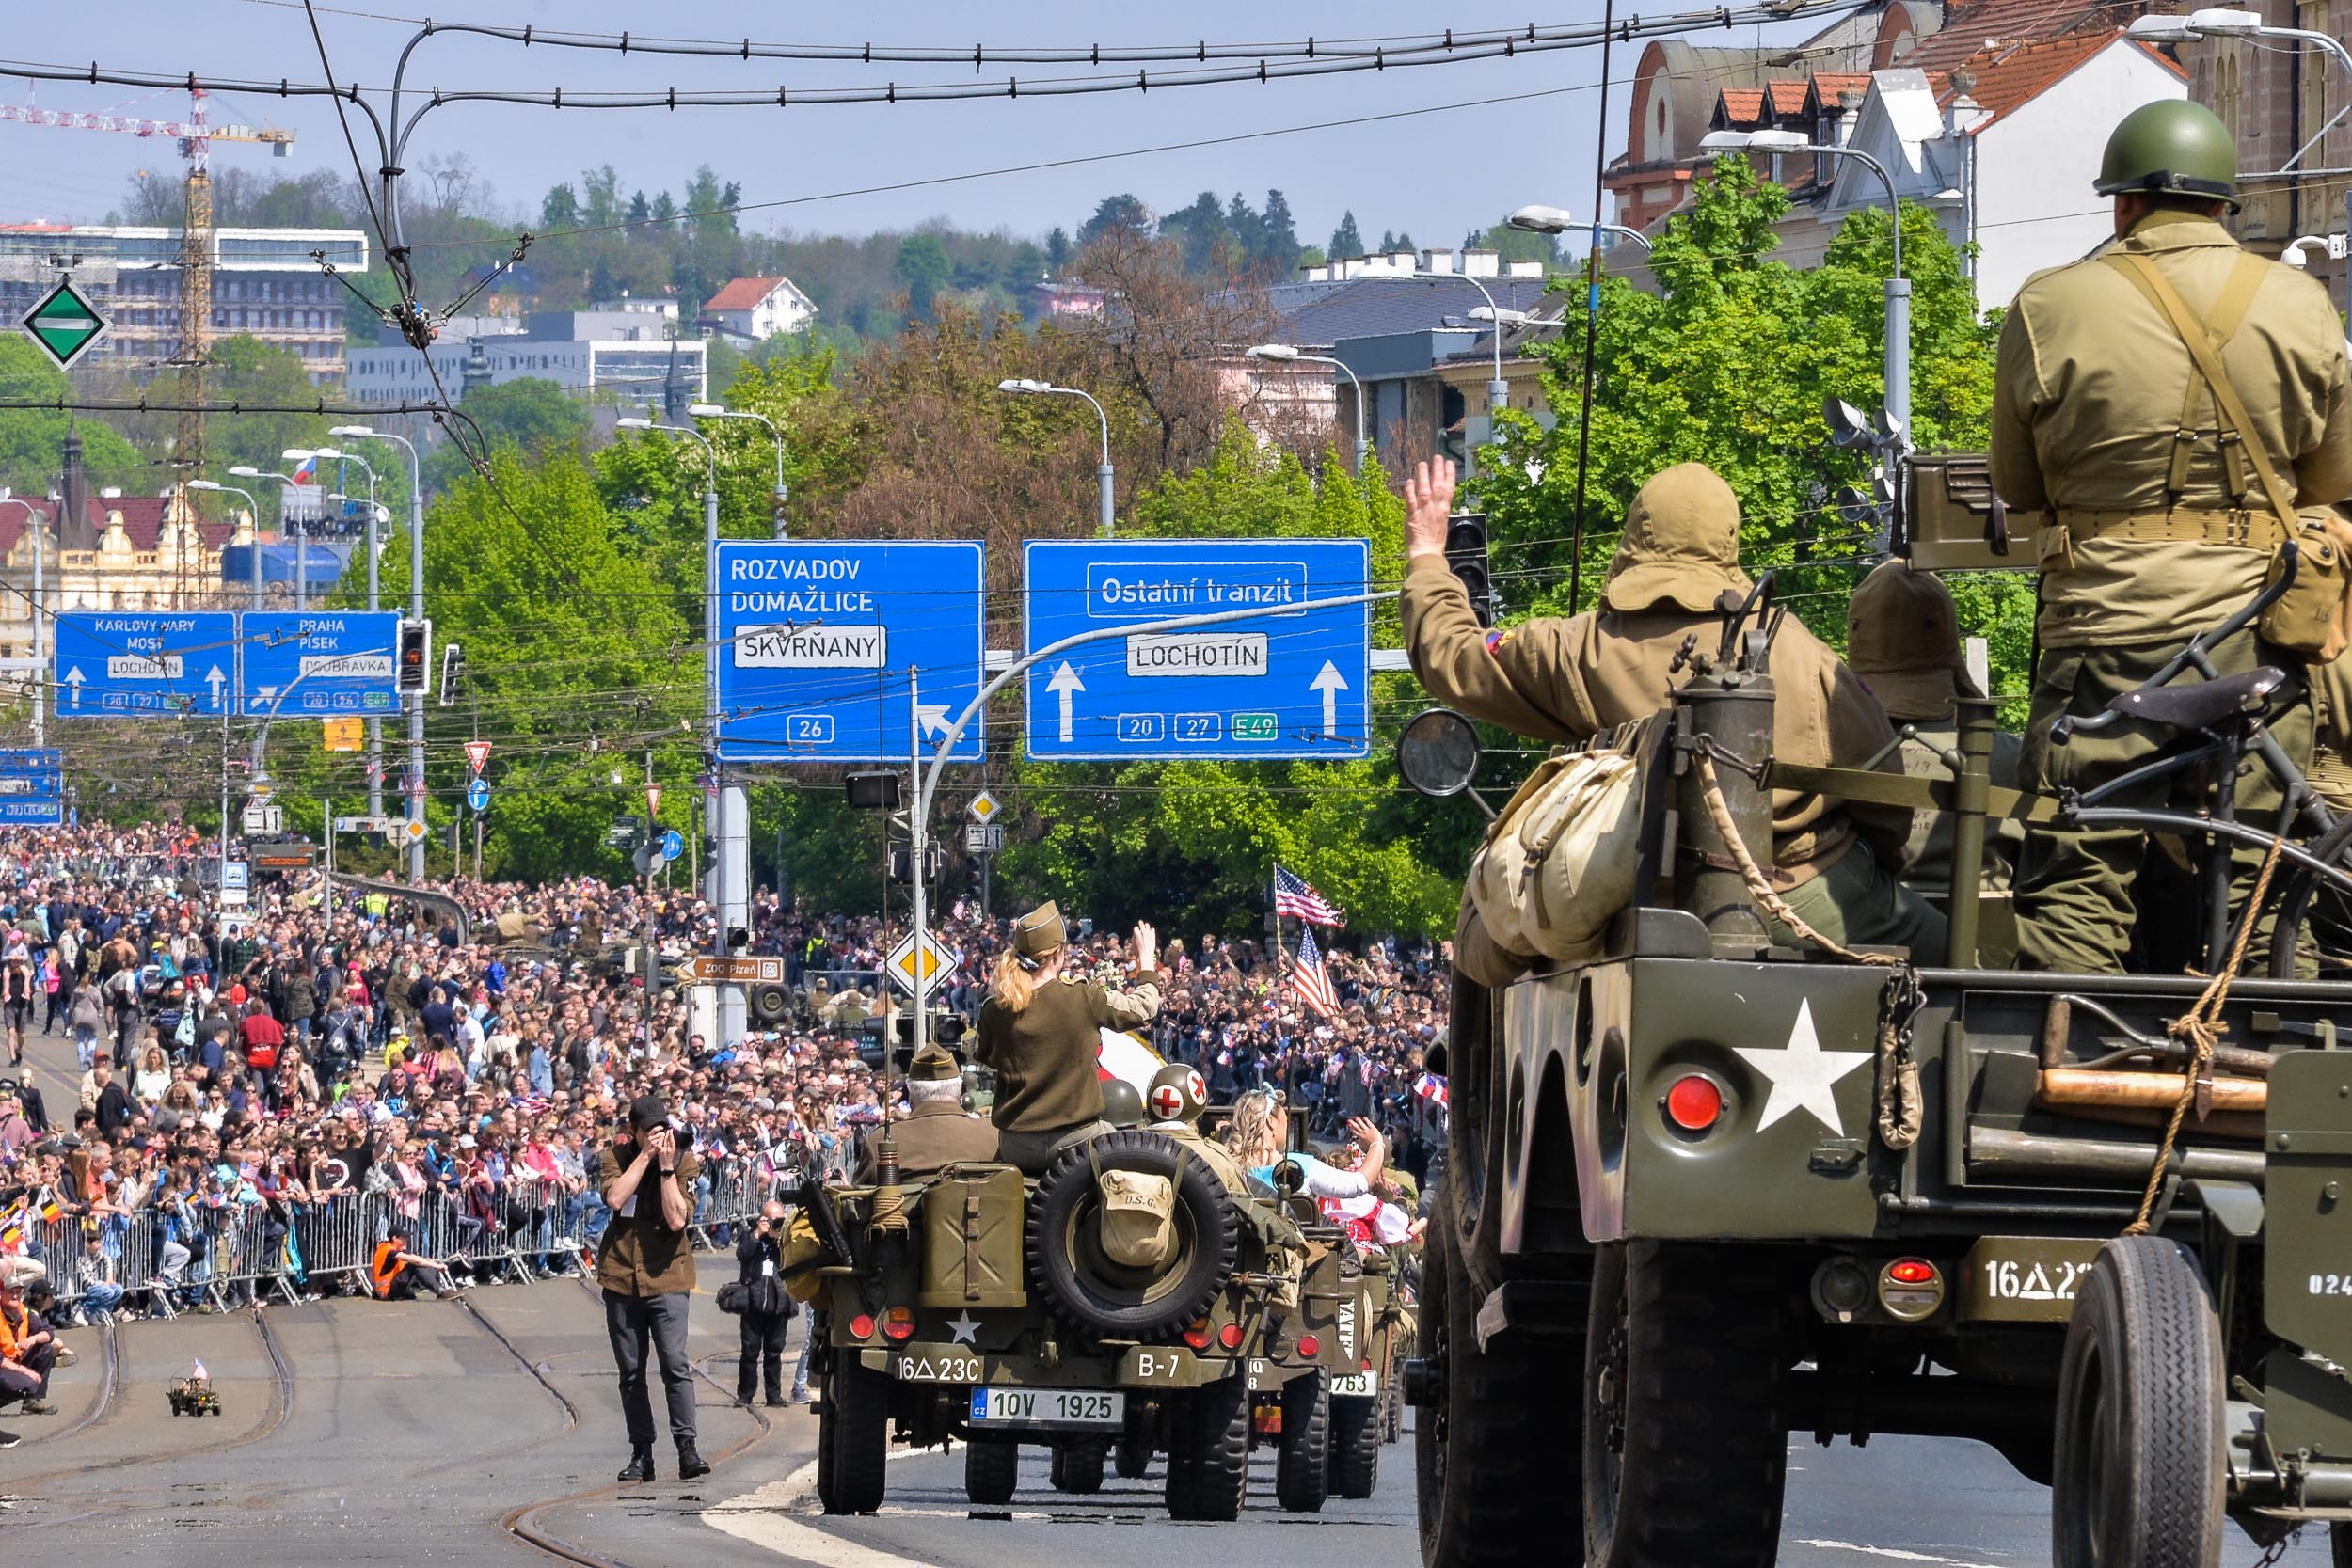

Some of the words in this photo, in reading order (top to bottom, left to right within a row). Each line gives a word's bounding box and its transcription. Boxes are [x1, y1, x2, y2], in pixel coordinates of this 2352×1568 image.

[731, 559, 861, 580] ROZVADOV
[731, 585, 874, 612] DOMAŽLICE
[1101, 577, 1195, 603] Ostatní
[1207, 577, 1292, 603] tranzit
[95, 620, 157, 632] KARLOVY
[299, 619, 345, 632] PRAHA
[299, 637, 339, 649] PÍSEK
[744, 632, 877, 657] SKVRŇANY
[1136, 638, 1259, 666] LOCHOTÍN
[800, 720, 822, 737] 26
[1129, 720, 1152, 736] 20
[1187, 719, 1210, 736] 27
[704, 963, 725, 974] ZOO
[729, 963, 756, 974] Plzeň
[1138, 1354, 1179, 1378] B-7
[994, 1392, 1036, 1418] 10V
[1056, 1394, 1112, 1419] 1925
